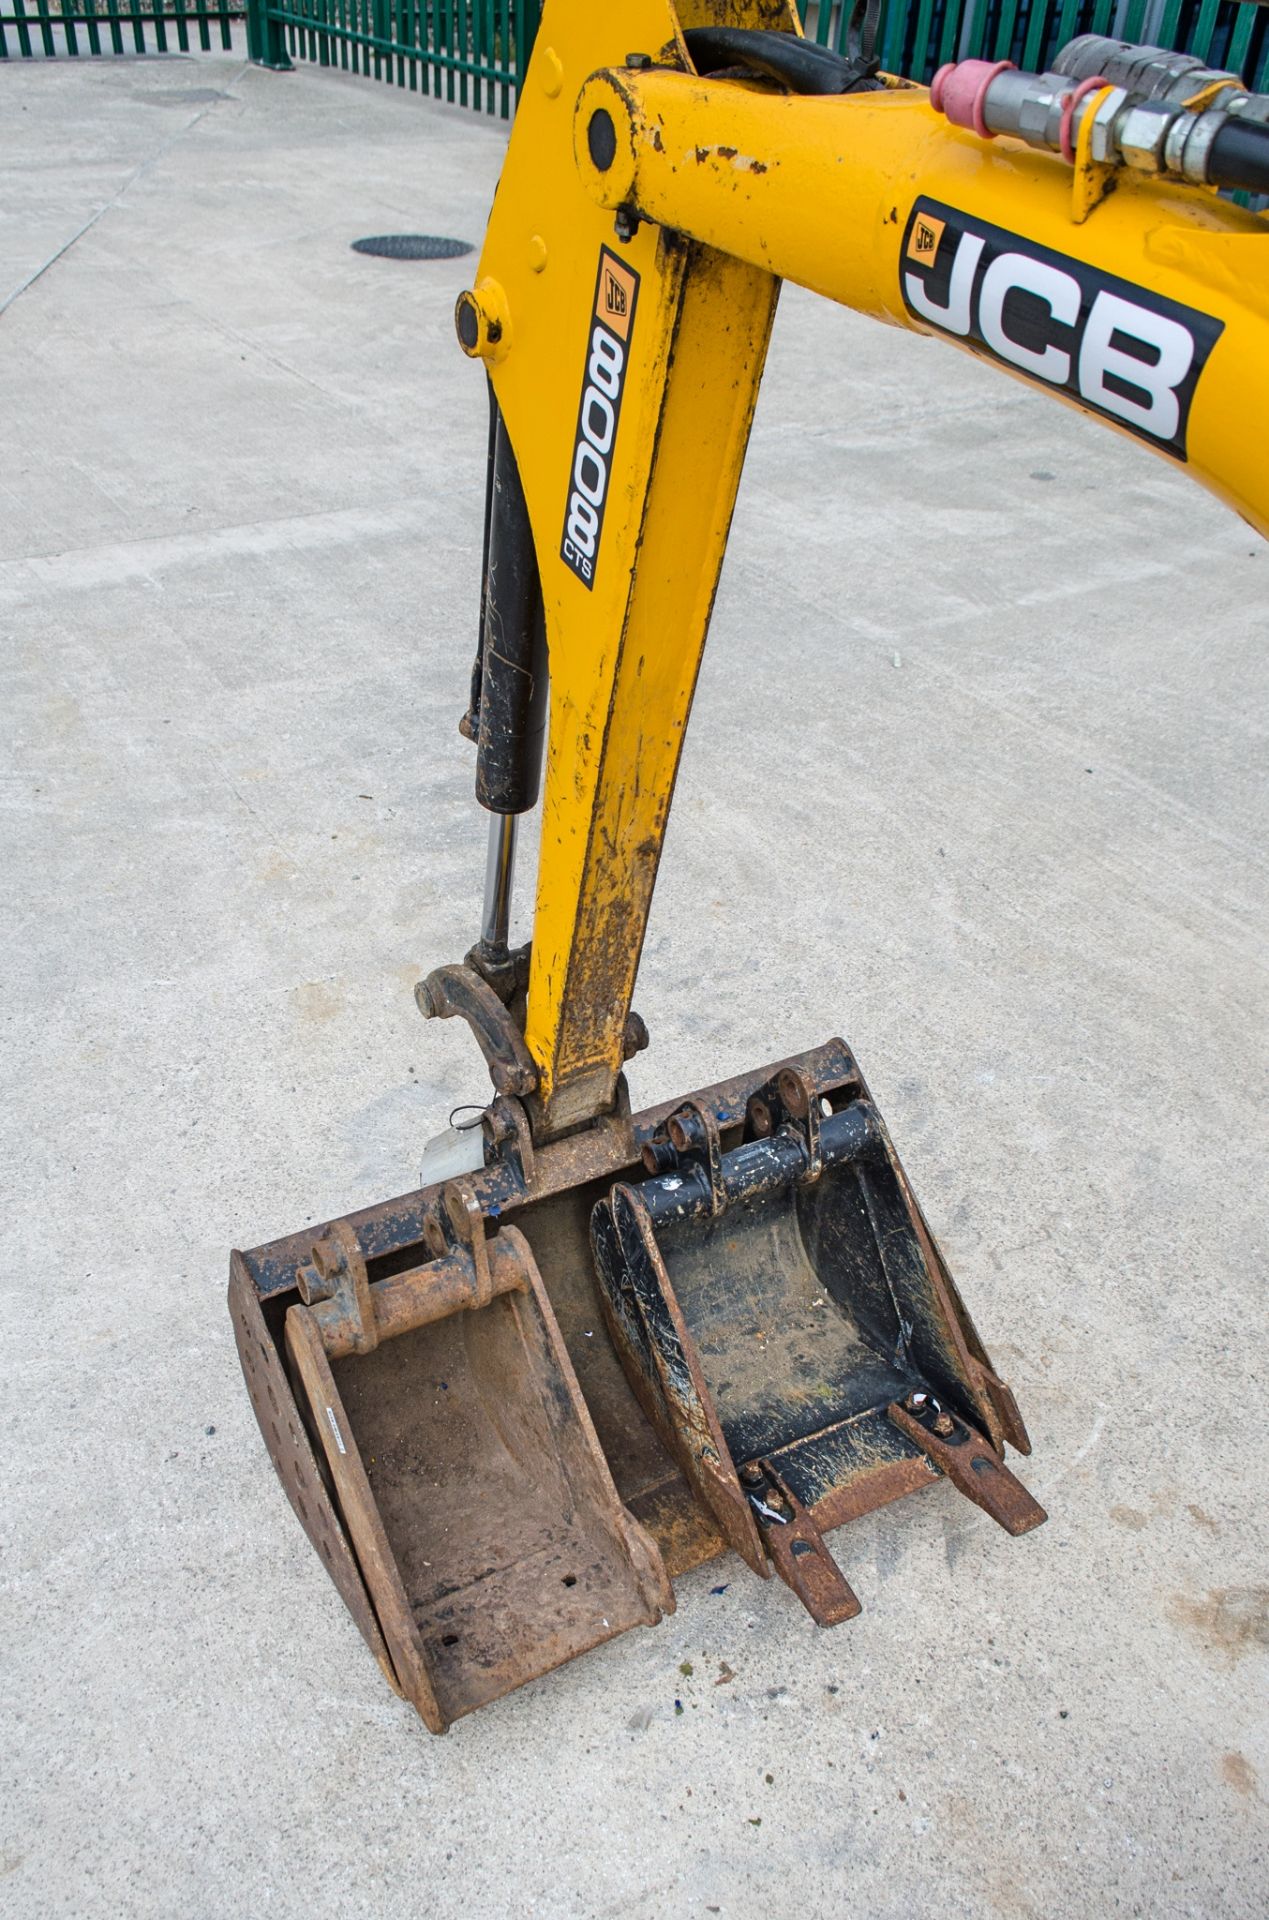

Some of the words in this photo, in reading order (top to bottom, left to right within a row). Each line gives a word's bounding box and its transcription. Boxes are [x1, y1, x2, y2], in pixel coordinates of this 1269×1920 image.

[917, 225, 935, 250] JCB
[607, 275, 626, 313] JCB
[905, 231, 1194, 440] JCB
[567, 326, 624, 558] 8008
[563, 538, 593, 579] CTS
